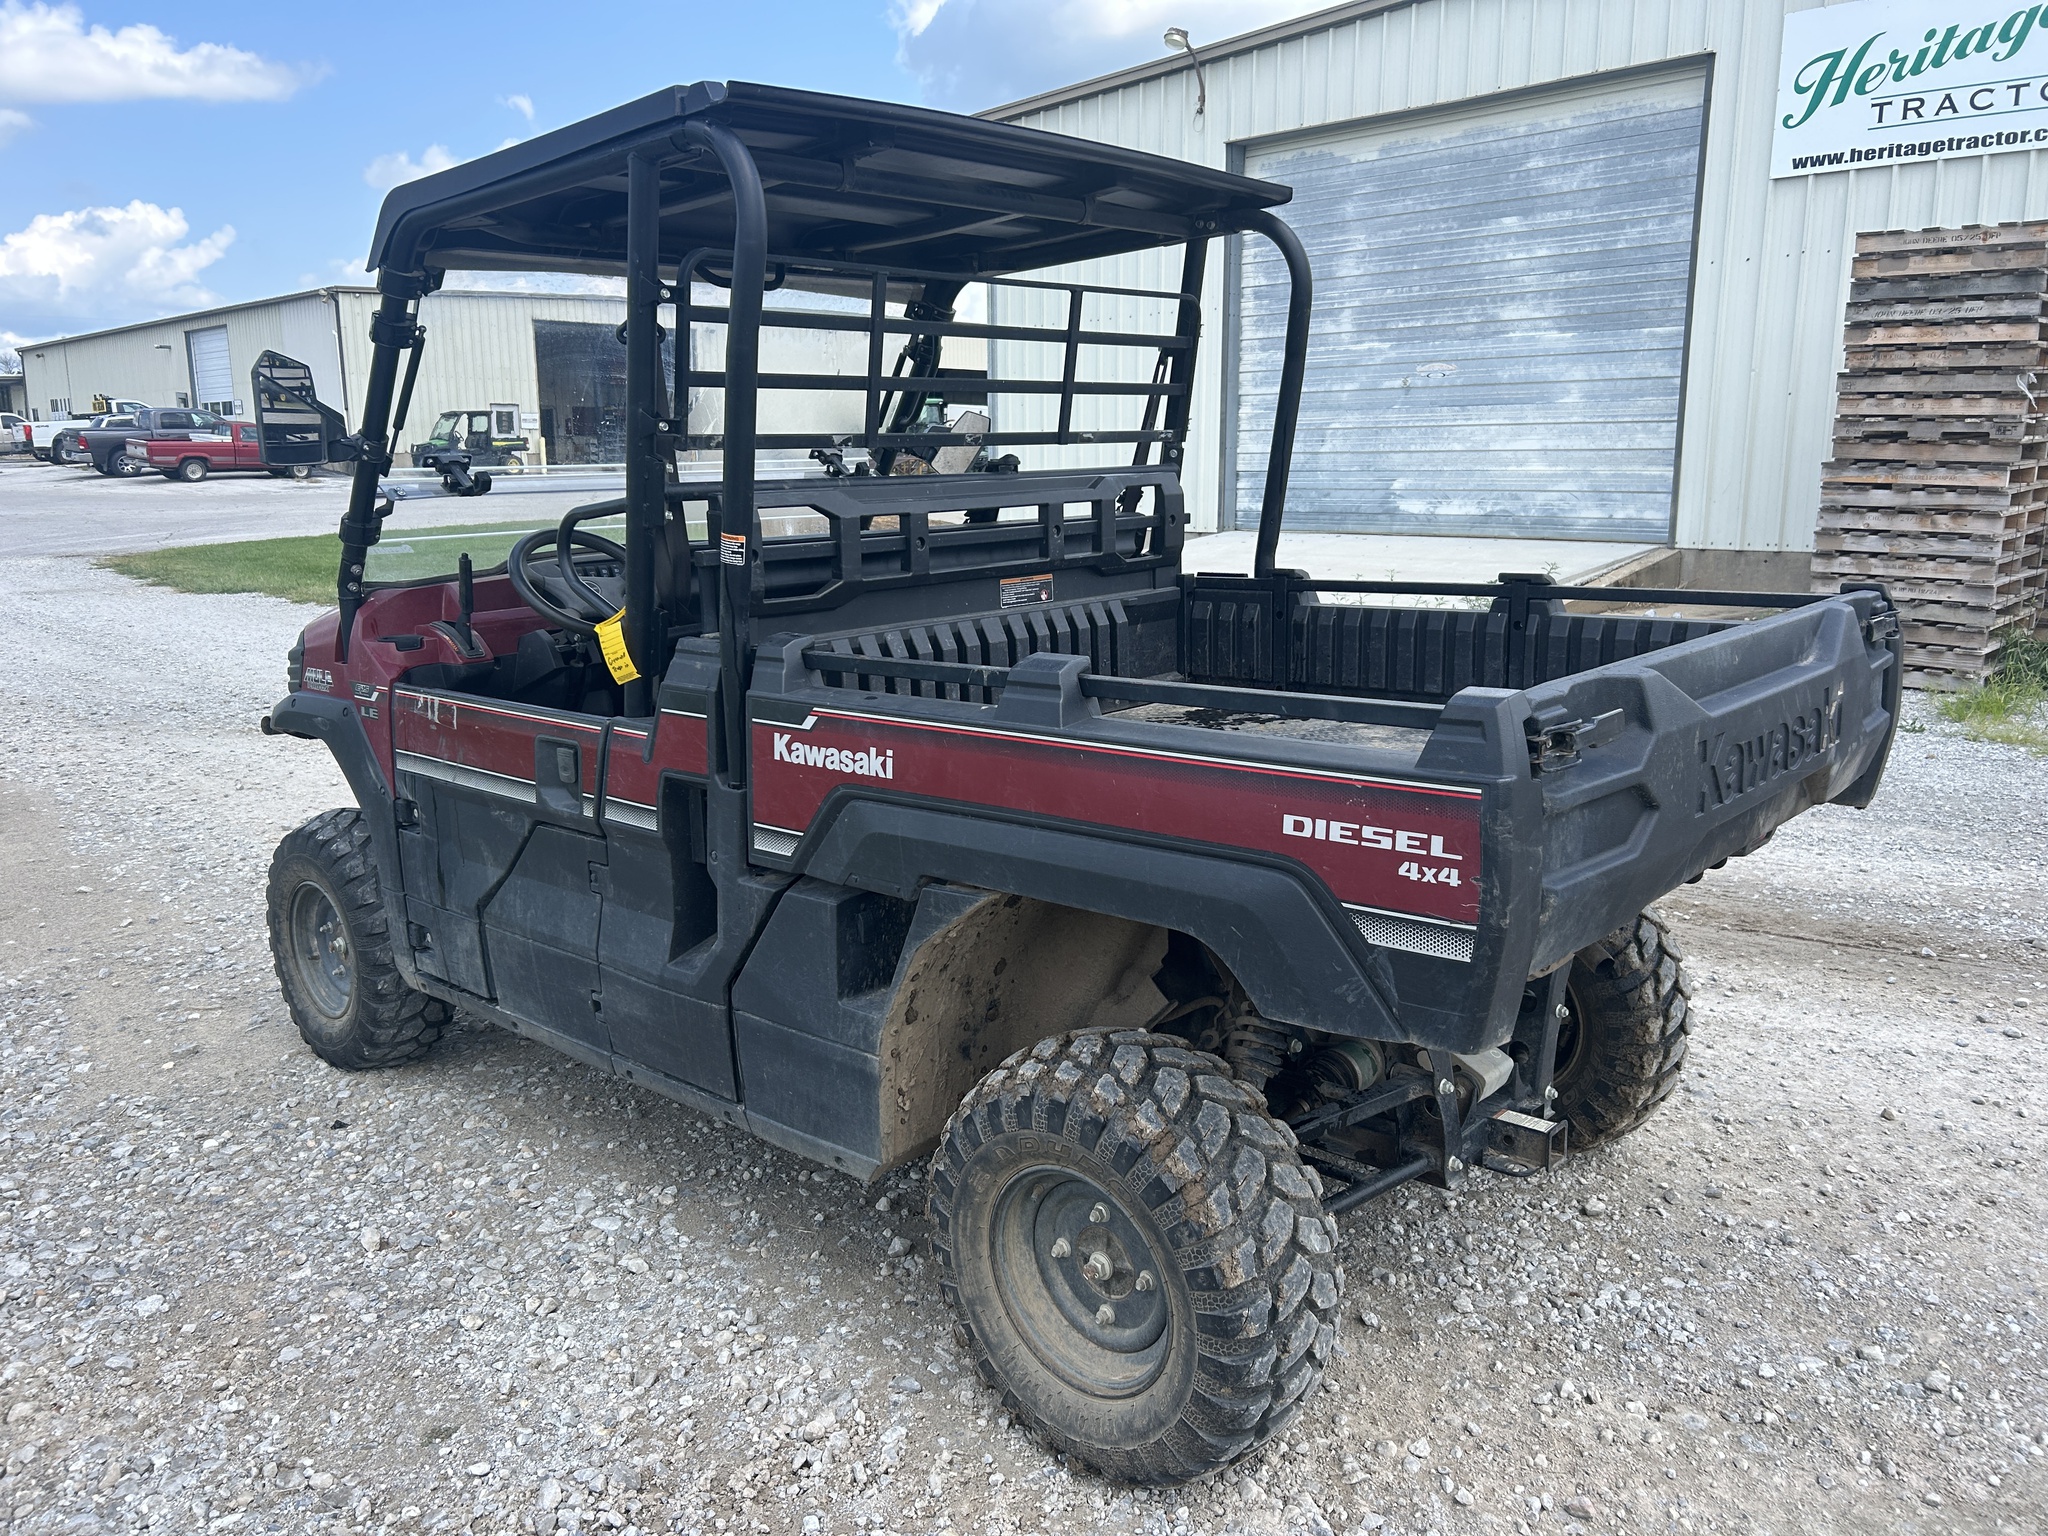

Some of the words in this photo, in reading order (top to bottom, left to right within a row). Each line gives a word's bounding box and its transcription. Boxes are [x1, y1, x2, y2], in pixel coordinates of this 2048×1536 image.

[1922, 236, 1948, 244] DEERE
[1951, 233, 1981, 242] 05/25
[303, 667, 334, 687] MULE
[361, 706, 379, 719] LE
[773, 732, 893, 779] Kawasaki
[1694, 680, 1845, 818] Kawasaki
[1282, 813, 1463, 861] DIESEL
[1398, 861, 1462, 888] 4x4
